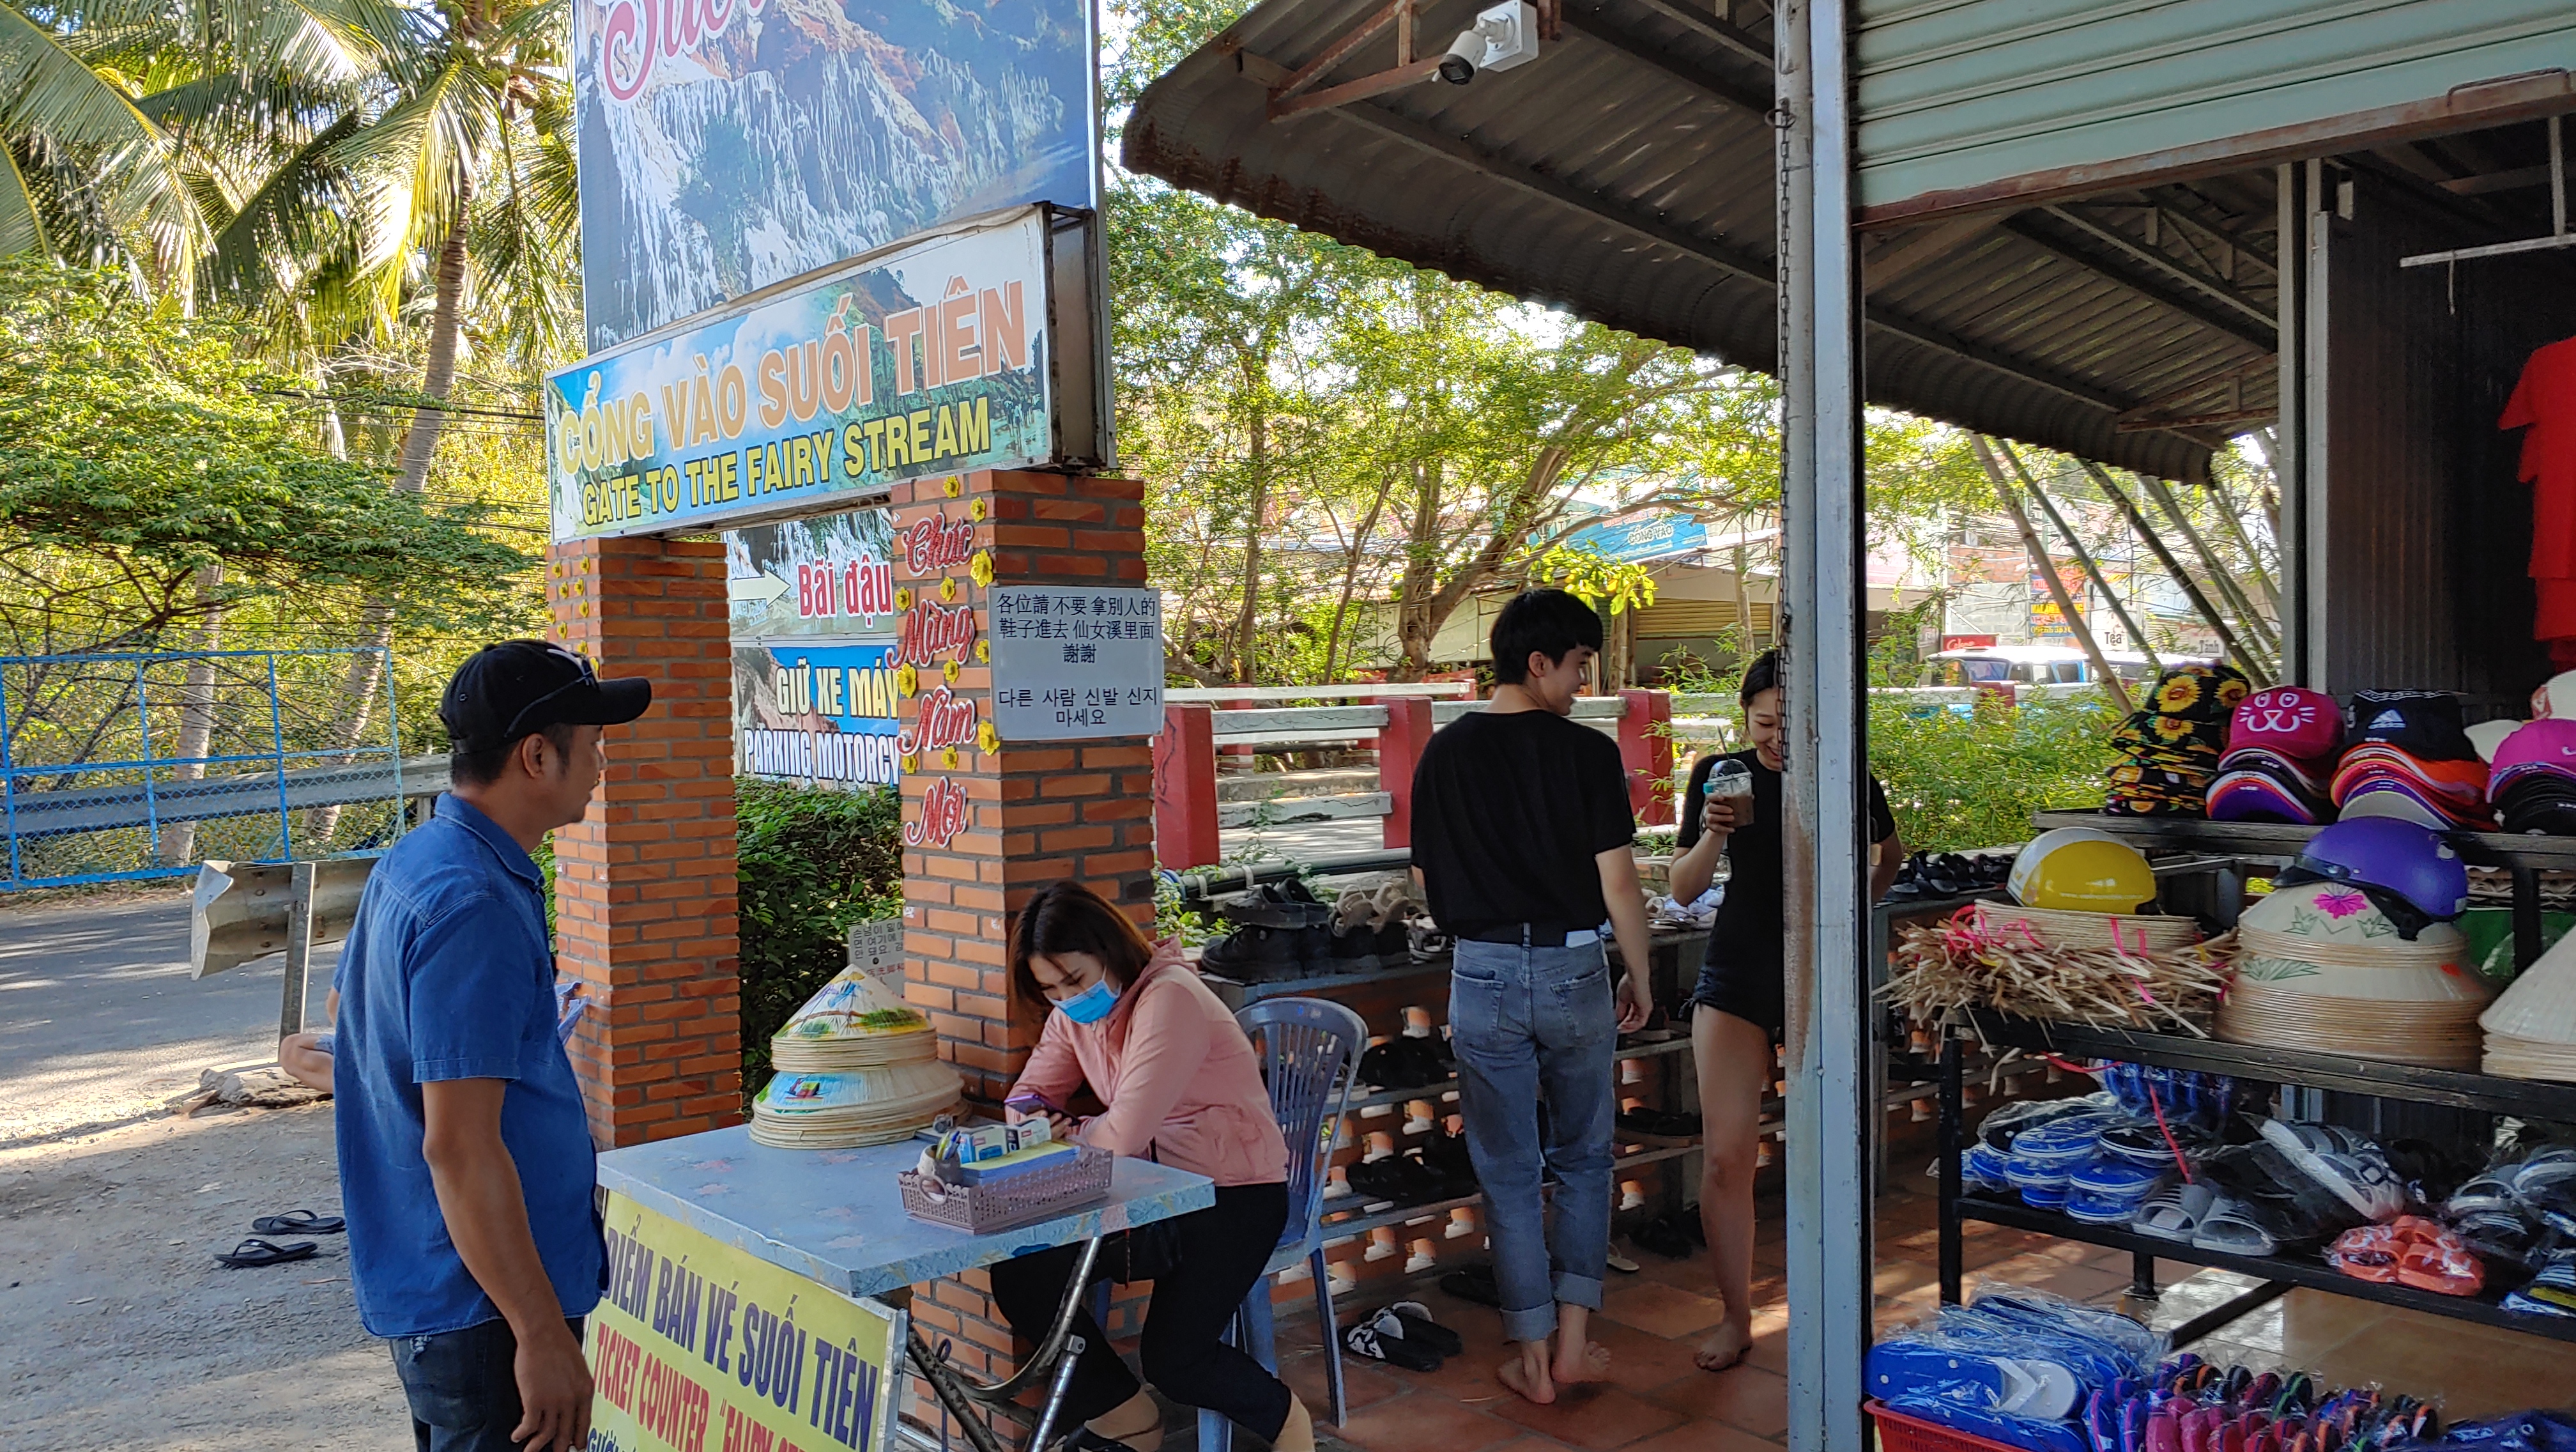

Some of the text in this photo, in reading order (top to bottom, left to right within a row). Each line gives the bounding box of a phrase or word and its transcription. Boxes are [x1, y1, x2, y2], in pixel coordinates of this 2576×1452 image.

[560, 275, 1026, 474] CỔNG VÀO SUỐI TIÊN
[583, 396, 991, 526] GATE TO THE FAIRY STREAM
[798, 553, 893, 626] Bãi đậu
[1062, 643, 1096, 663] 謝謝
[776, 656, 899, 720] GIỮ XE MÁY
[999, 686, 1158, 707] 다른 사람 신발 신지
[1056, 708, 1107, 727] 마세요
[744, 727, 811, 778] PARKING
[593, 1321, 641, 1415] TICKET
[638, 1352, 709, 1452] COUNTER
[652, 1255, 702, 1354] BÁN
[703, 1281, 738, 1375] VÉ
[738, 1294, 806, 1416] SUỐI
[809, 1337, 878, 1452] TIÊN
